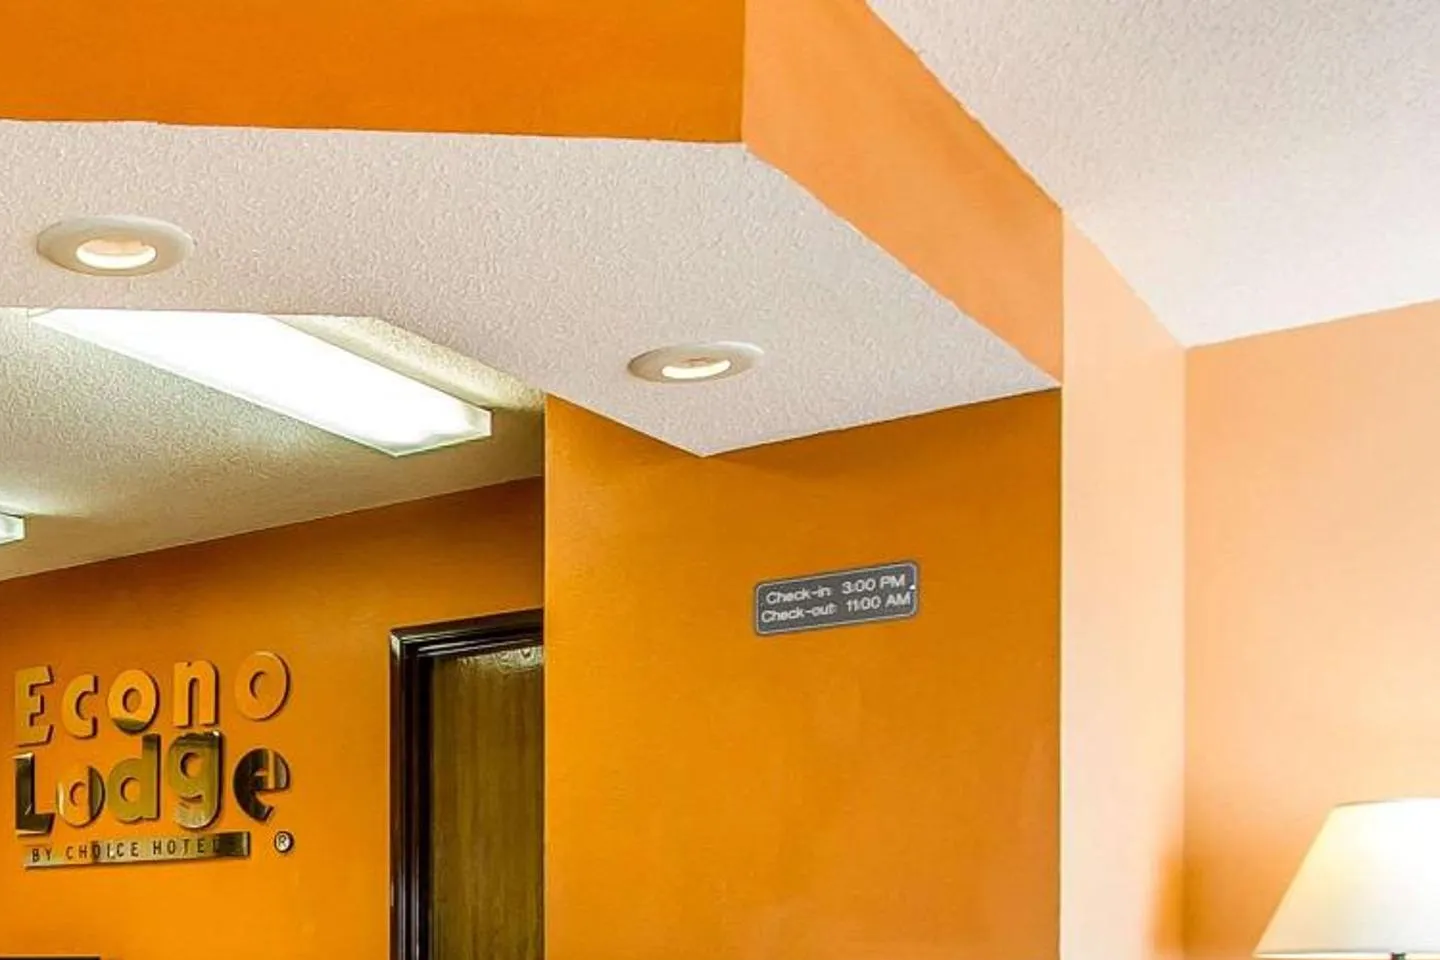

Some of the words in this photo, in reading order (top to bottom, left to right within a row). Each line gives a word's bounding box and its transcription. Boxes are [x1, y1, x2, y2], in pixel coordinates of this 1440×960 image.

[879, 573, 906, 590] PM
[884, 591, 912, 607] AM
[13, 650, 291, 747] Econo
[12, 730, 292, 837] Lodge
[31, 847, 52, 863] BY
[65, 841, 139, 860] CHOICE
[152, 834, 237, 857] HOTEL
